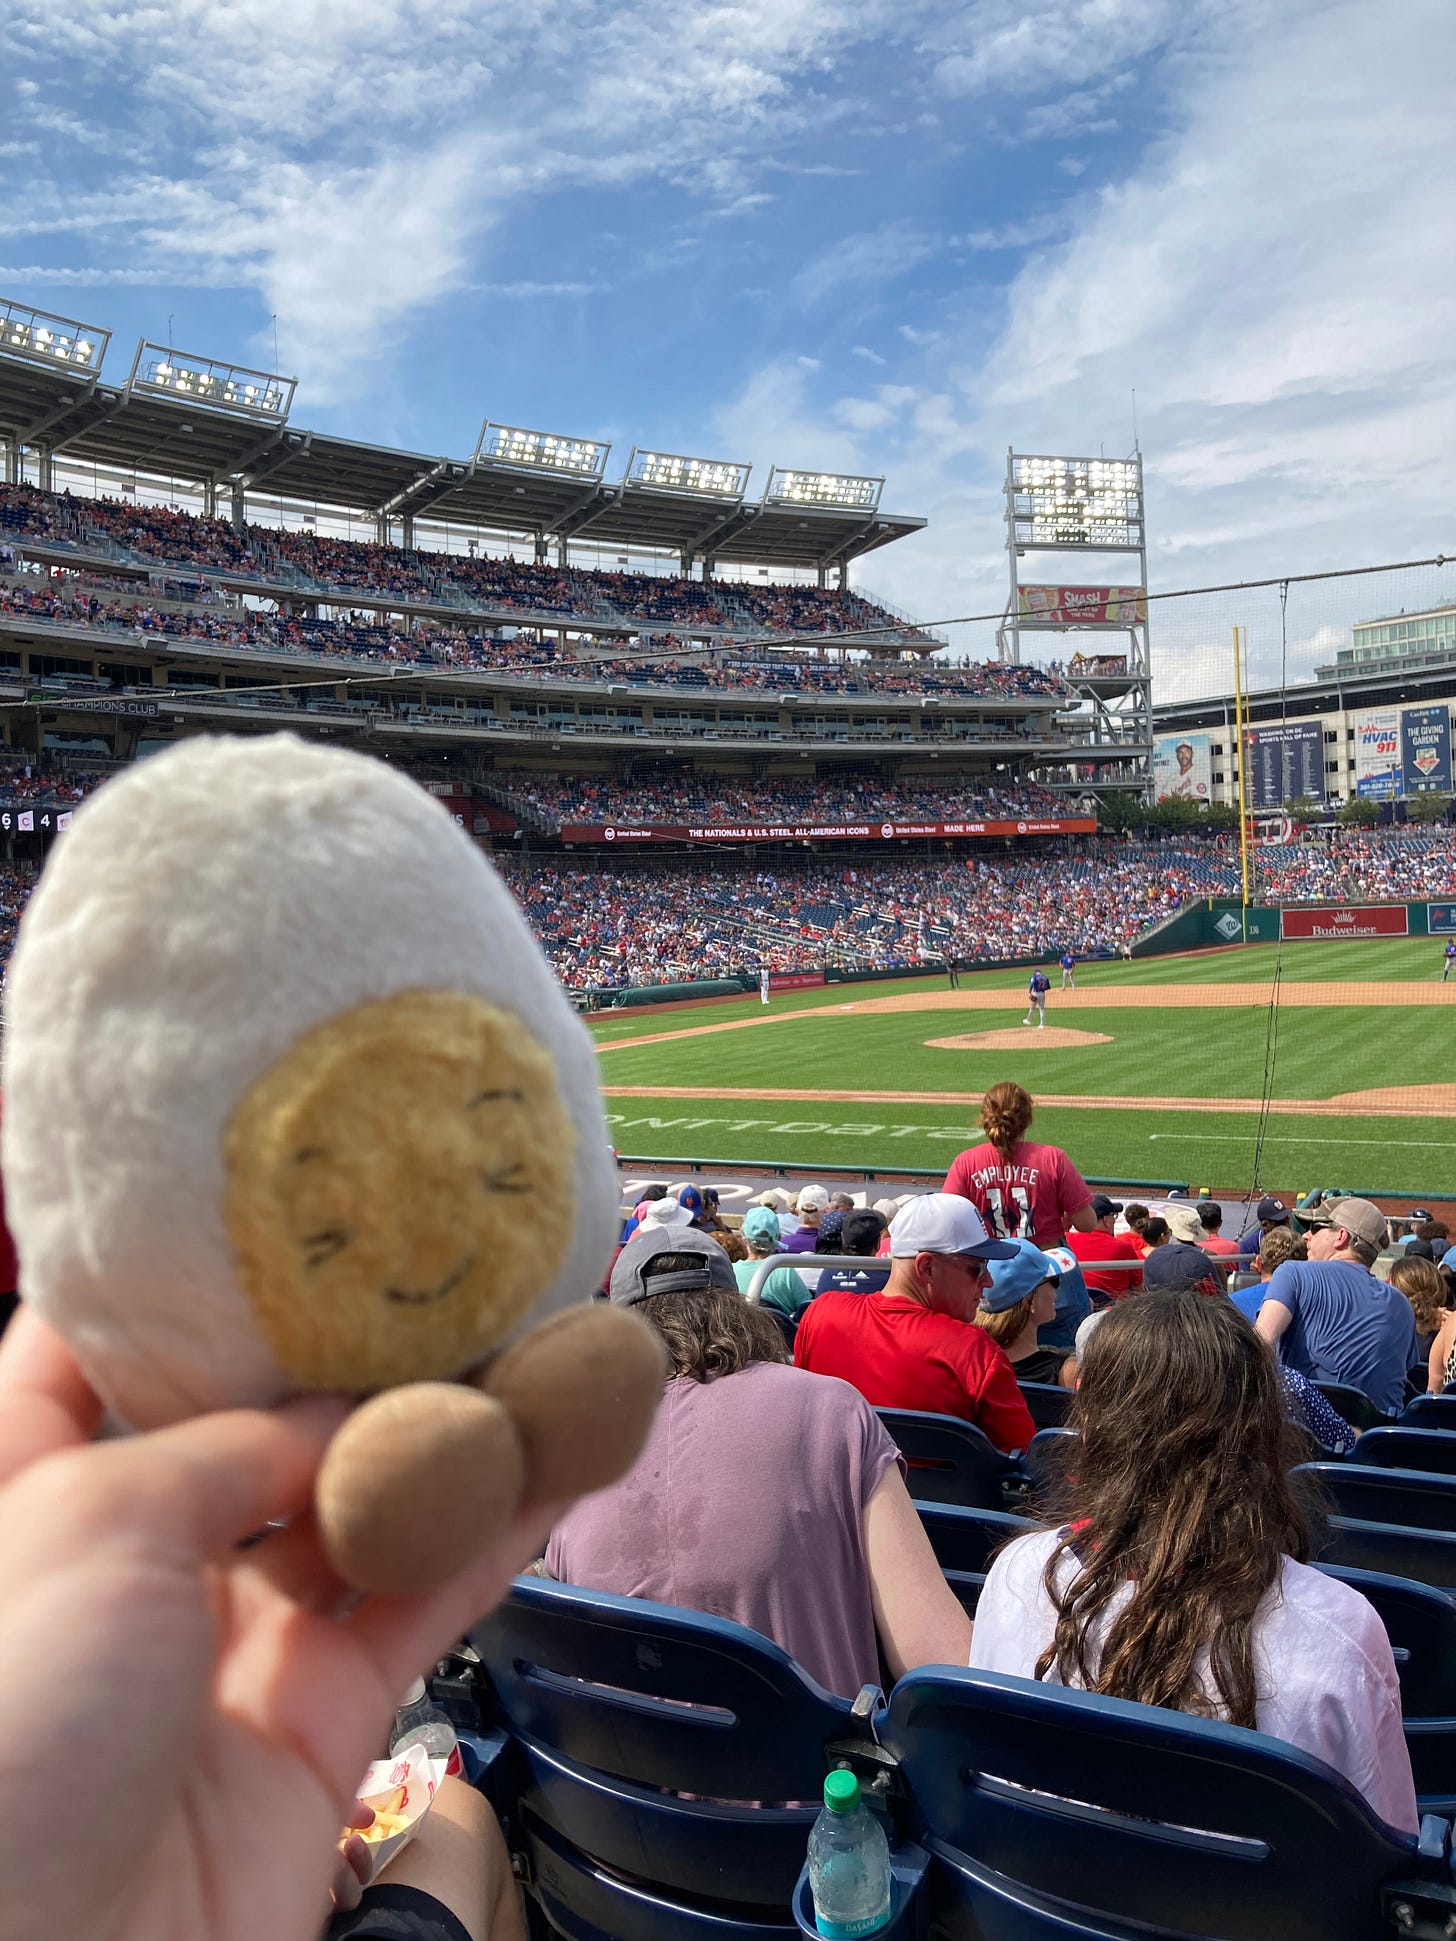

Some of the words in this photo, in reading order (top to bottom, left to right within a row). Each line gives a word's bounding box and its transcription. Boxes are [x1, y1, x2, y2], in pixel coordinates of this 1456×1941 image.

[1064, 591, 1100, 608] SMASH
[128, 703, 156, 715] CLUB
[1407, 727, 1420, 737] THE
[1420, 724, 1444, 735] GIVING
[1363, 731, 1398, 744] HVAC
[1412, 734, 1440, 746] GARDEN
[1377, 741, 1397, 753] 911
[2, 813, 11, 826] 6
[41, 814, 51, 827] 4
[689, 829, 703, 837] THE
[704, 829, 746, 837] NATIONALS
[770, 828, 794, 836] STEEL.
[795, 828, 845, 836] ALL-AMERICAN
[847, 827, 869, 835] ICONS
[944, 825, 964, 833] MADE
[966, 824, 985, 832] HERE
[1312, 924, 1377, 936] Budweiser
[971, 1165, 1039, 1189] EMPLOYEE
[985, 1187, 1036, 1239] 11
[846, 1915, 876, 1932] DASANI
